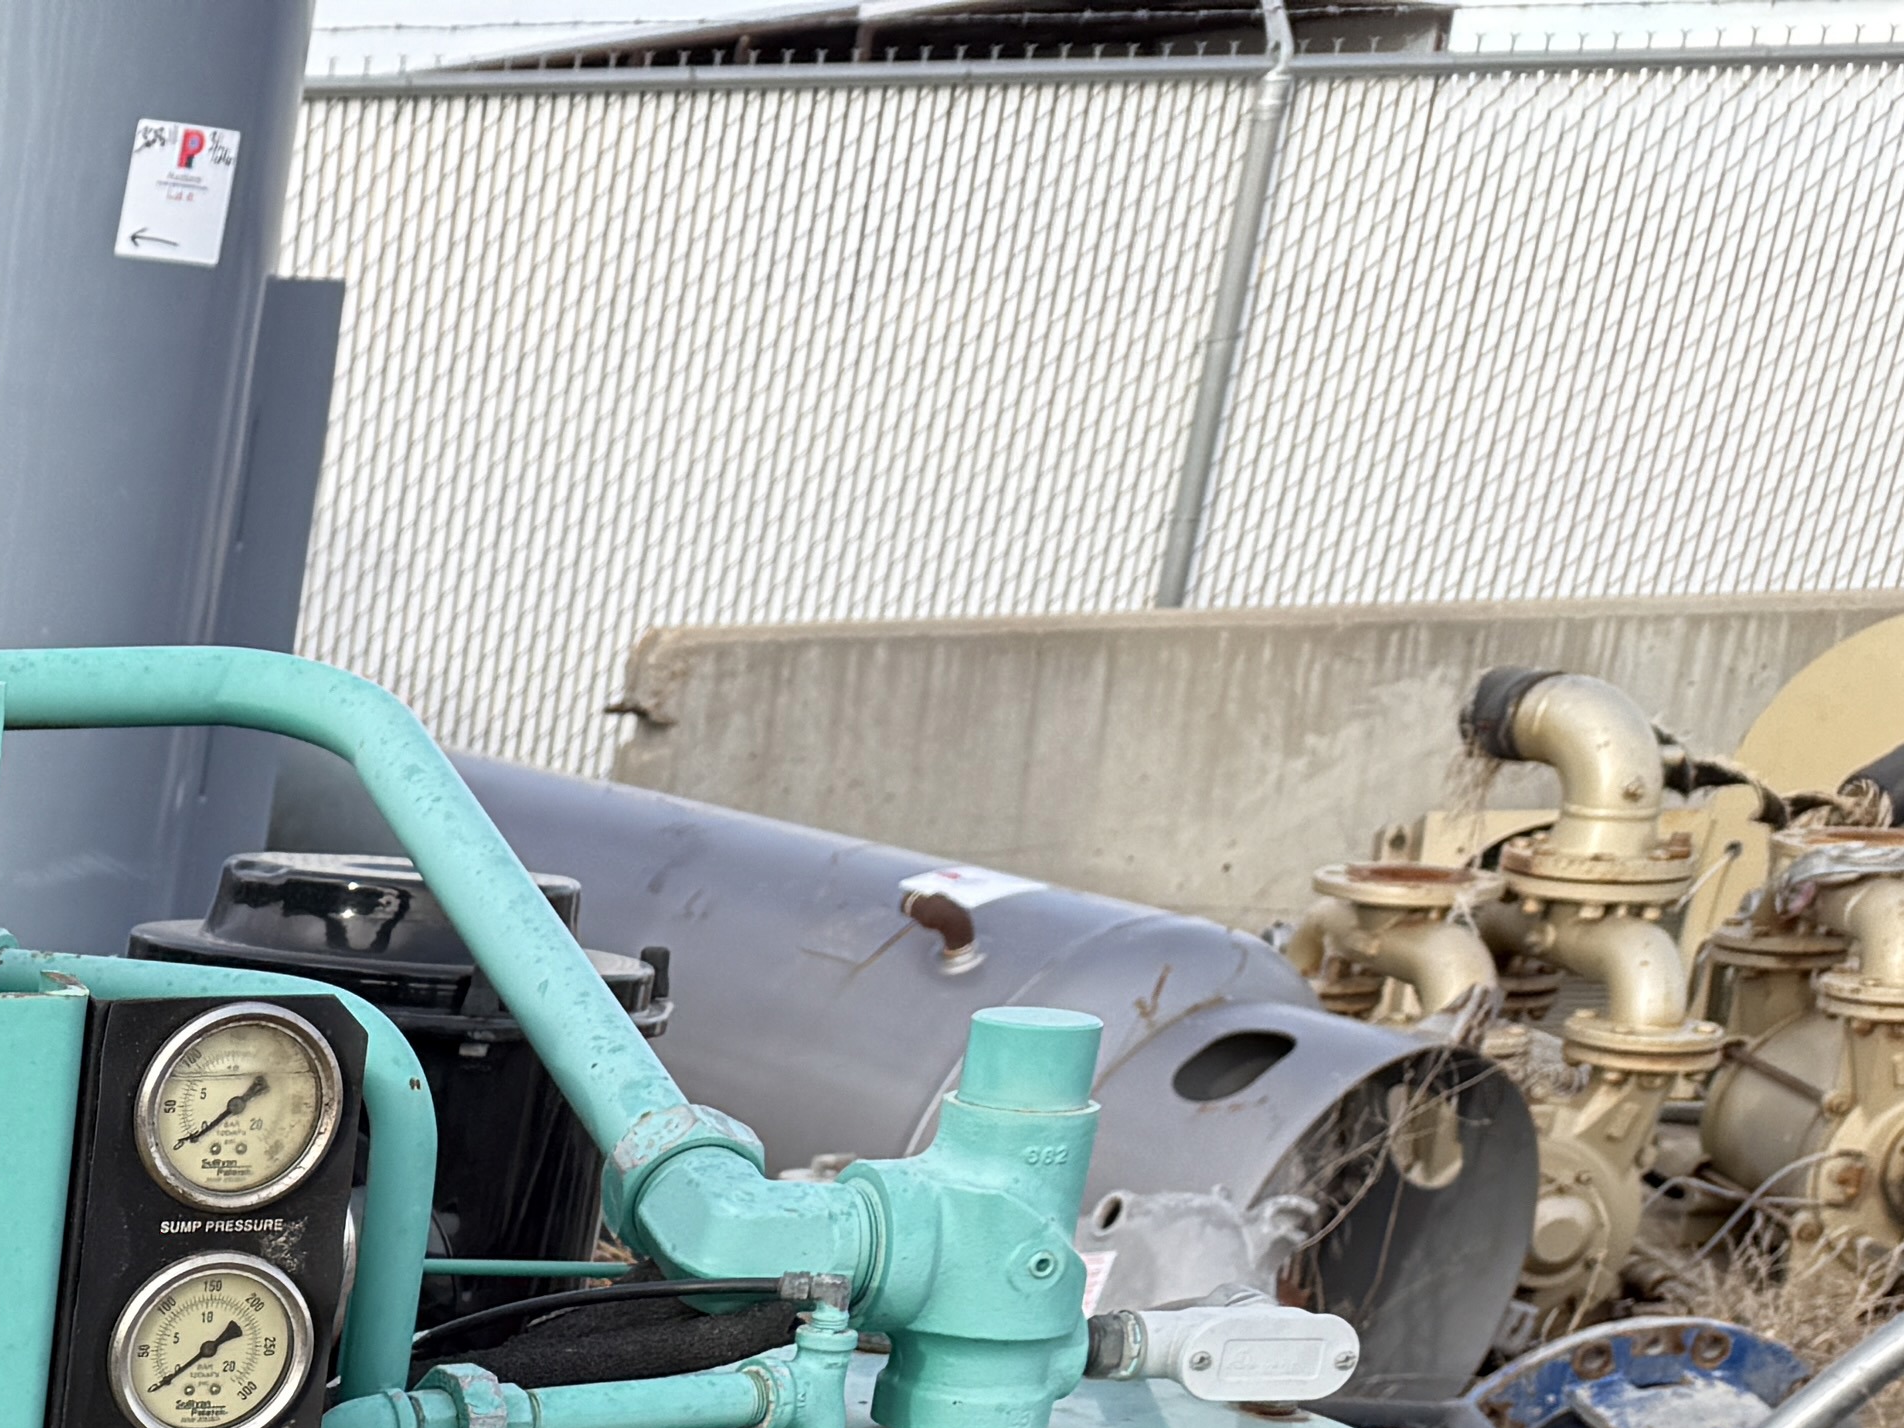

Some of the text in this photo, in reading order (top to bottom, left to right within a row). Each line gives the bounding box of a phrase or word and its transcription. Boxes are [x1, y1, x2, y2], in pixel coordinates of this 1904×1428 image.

[200, 1088, 207, 1100] 5
[164, 1100, 176, 1114] 50
[250, 1118, 263, 1130] 20
[160, 1219, 284, 1233] SUMP PRESSURE
[204, 1280, 222, 1291] 150
[157, 1296, 176, 1315] 100
[245, 1293, 264, 1312] 200
[202, 1311, 213, 1322] 10
[173, 1332, 179, 1344] 5
[138, 1344, 150, 1358] 50
[264, 1337, 275, 1356] 250
[223, 1361, 235, 1372] 20
[238, 1381, 257, 1400] 300
